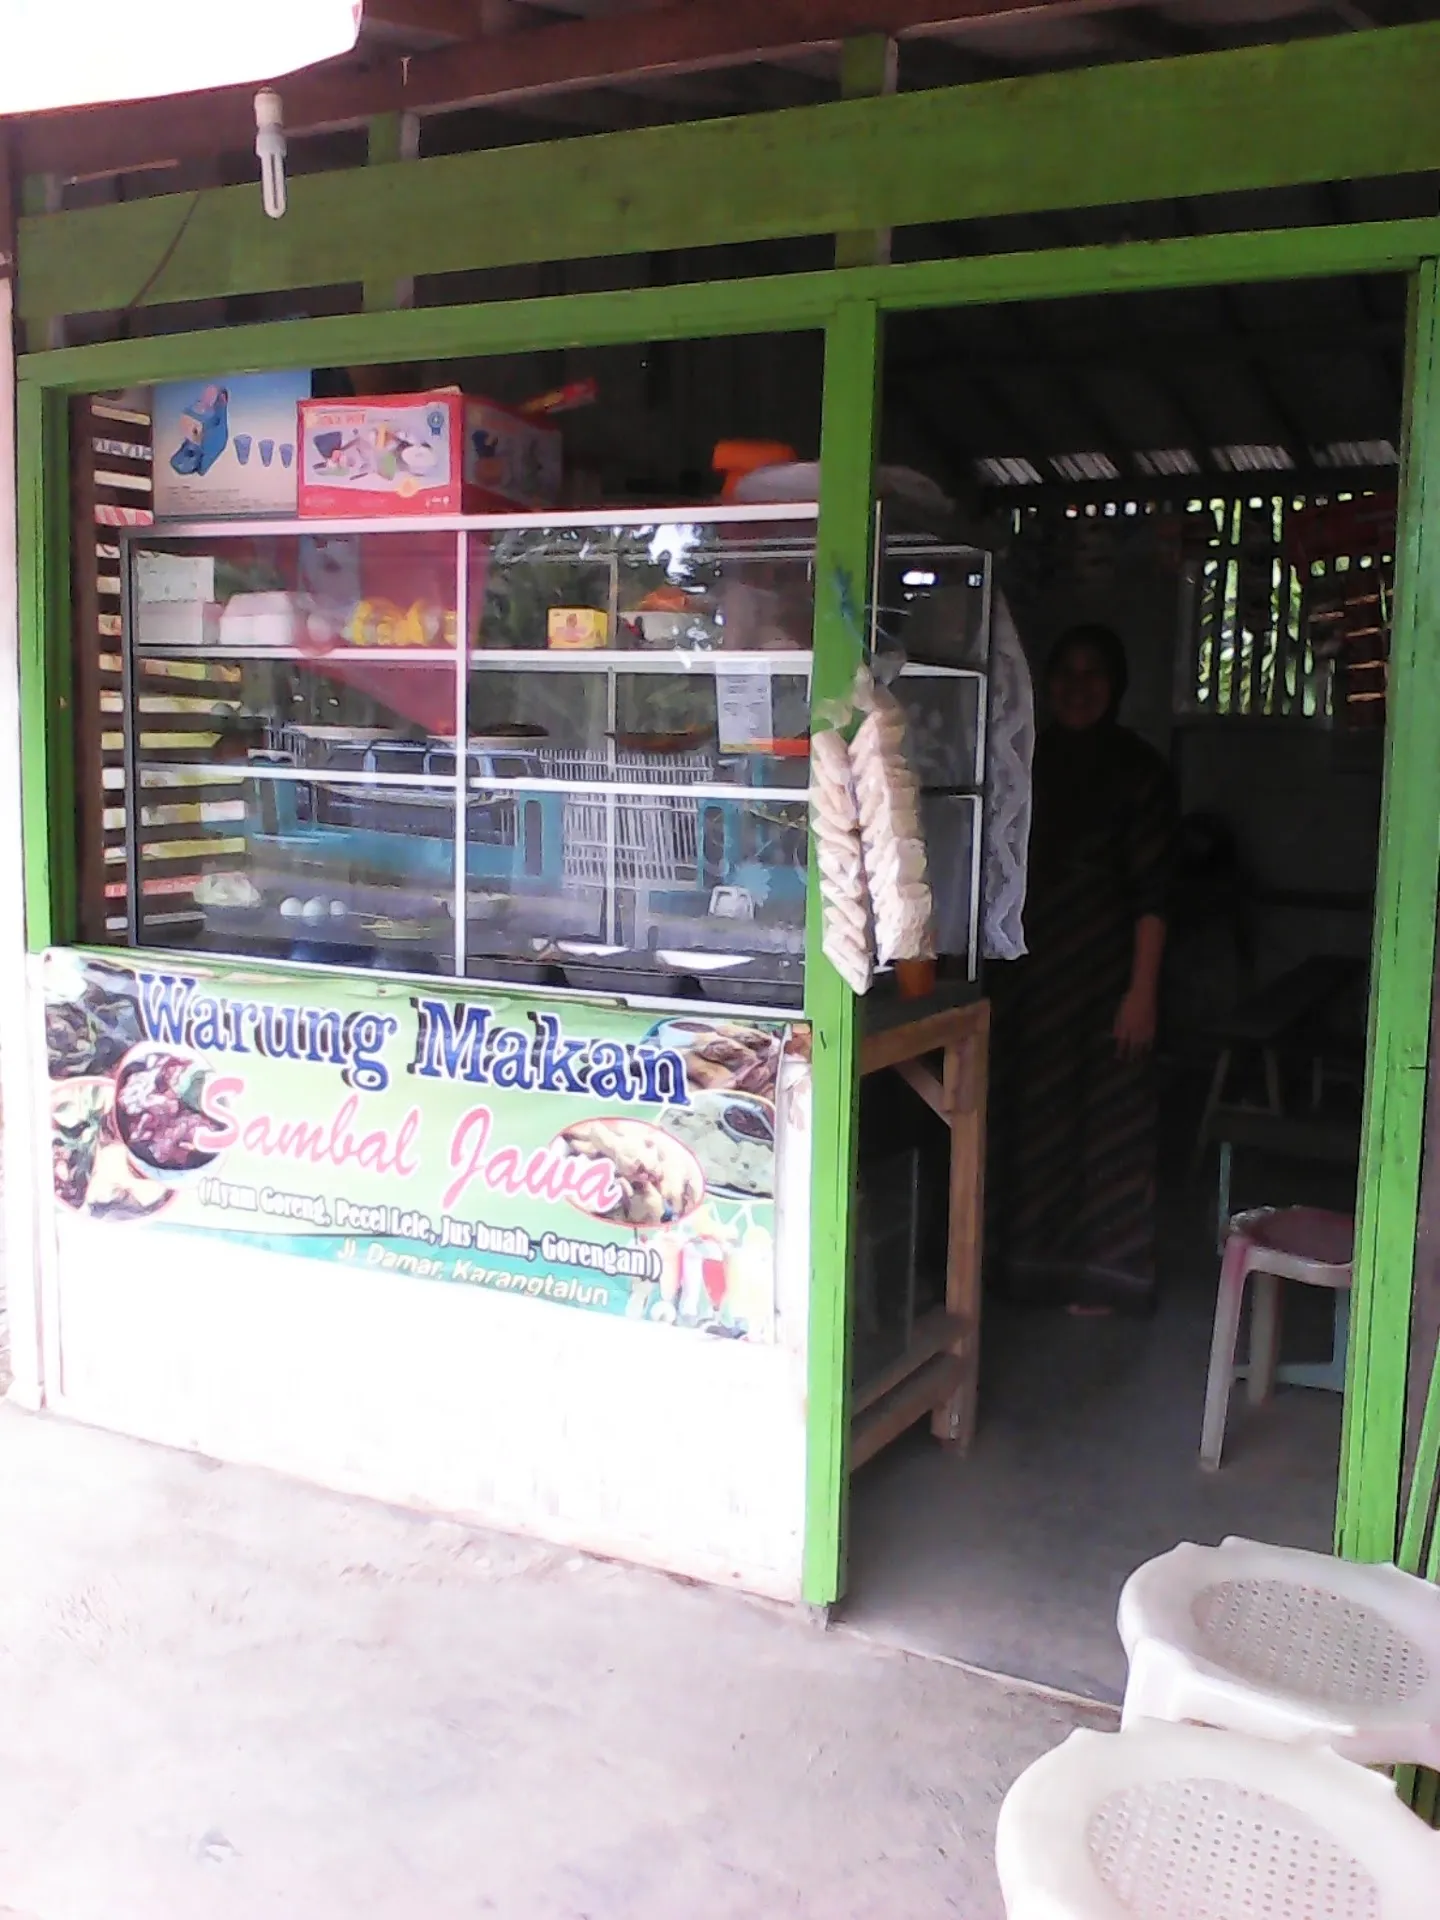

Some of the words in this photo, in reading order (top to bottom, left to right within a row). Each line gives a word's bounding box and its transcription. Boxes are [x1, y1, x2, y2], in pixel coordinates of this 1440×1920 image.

[138, 973, 399, 1091] Warung
[406, 997, 691, 1106] Makan
[198, 1076, 420, 1176] Sambal
[442, 1106, 622, 1210] Jawa
[336, 1199, 388, 1234] Pecel
[440, 1215, 473, 1247] Jus
[453, 1259, 609, 1306] Karangtalun
